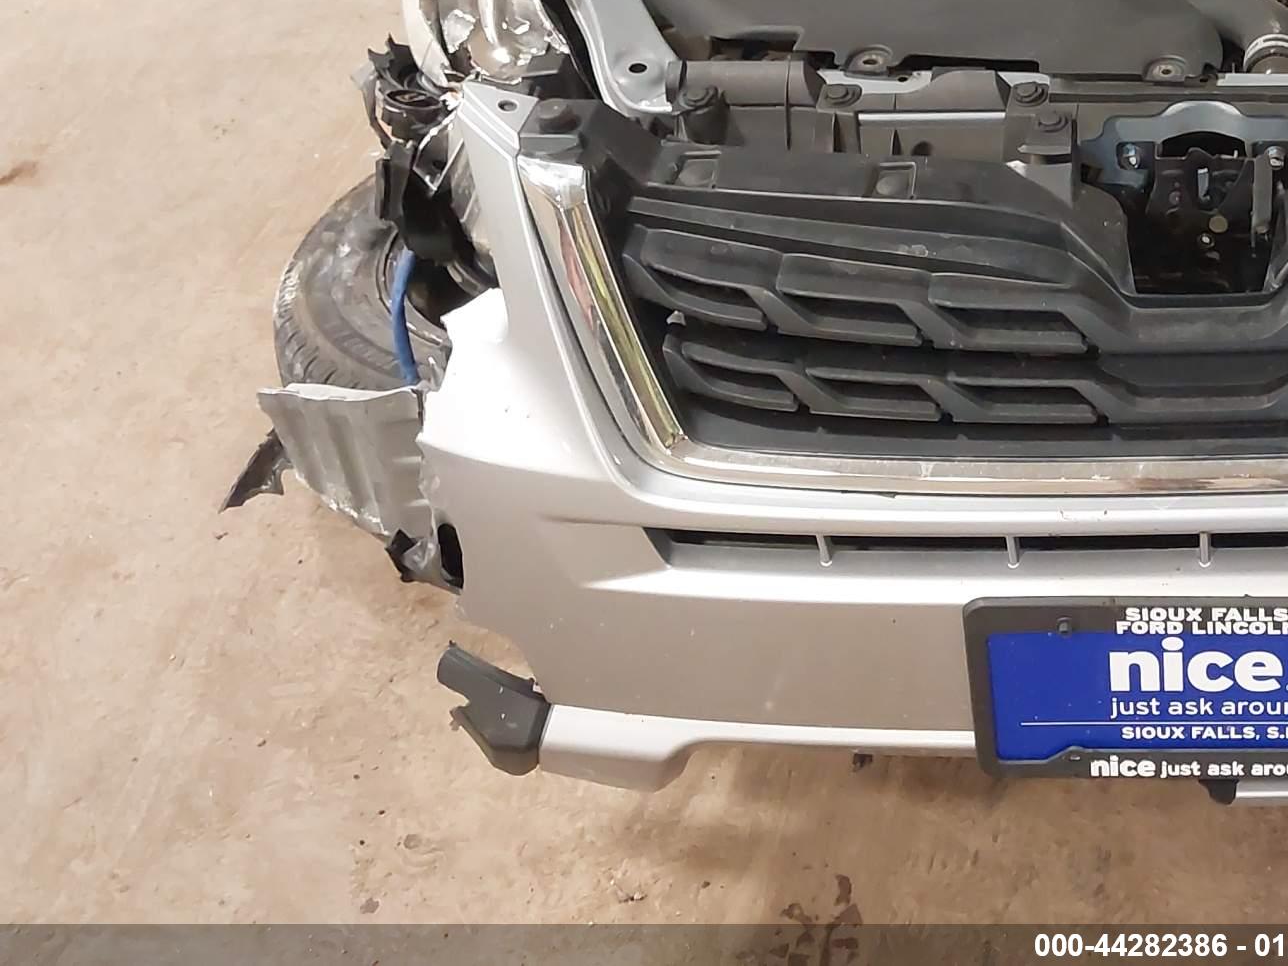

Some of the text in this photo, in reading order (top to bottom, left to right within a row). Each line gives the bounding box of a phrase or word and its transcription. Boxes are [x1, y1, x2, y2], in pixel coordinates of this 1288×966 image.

[1125, 607, 1288, 621] SIOUX FALLS
[1116, 621, 1184, 635] FORD
[1110, 697, 1161, 719] just
[1168, 697, 1214, 715] ask
[1121, 726, 1185, 740] SIOUX
[1191, 726, 1260, 741] FALLS,
[1090, 754, 1156, 777] nice
[1160, 760, 1201, 779] just
[1207, 760, 1245, 776] ask
